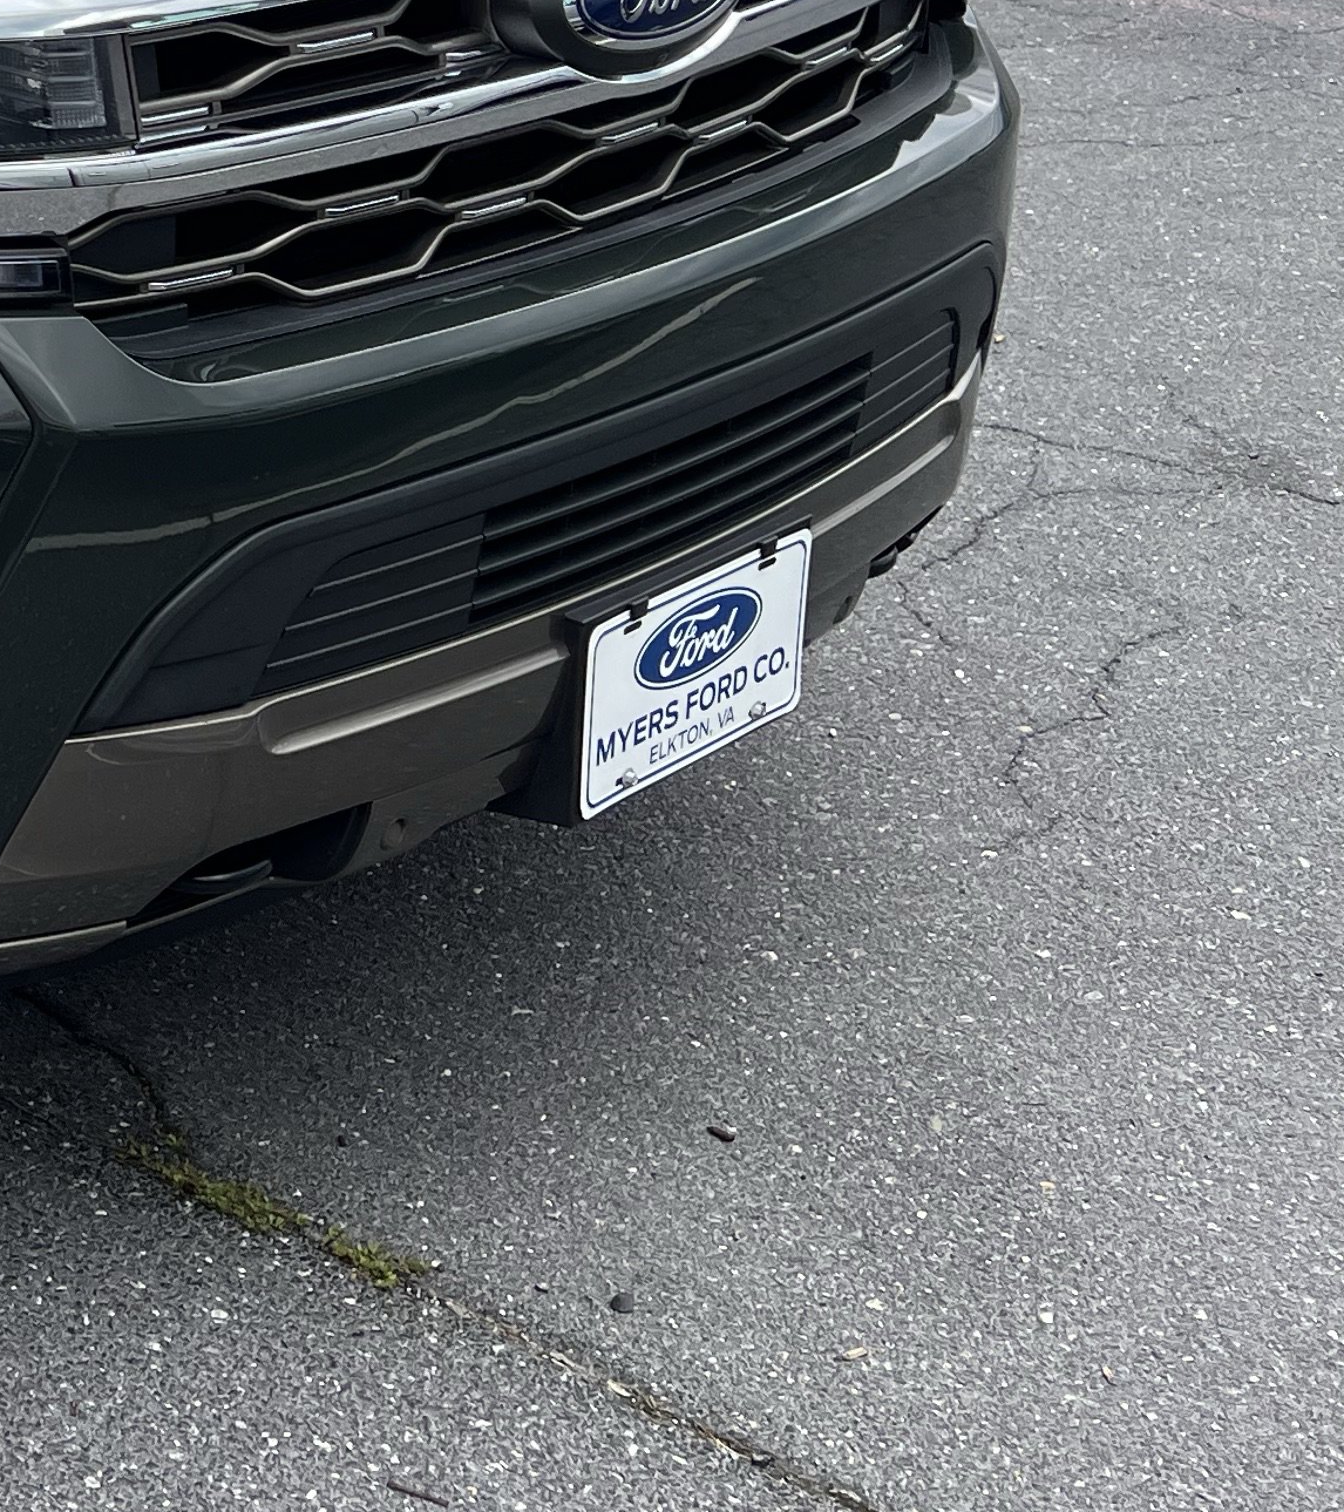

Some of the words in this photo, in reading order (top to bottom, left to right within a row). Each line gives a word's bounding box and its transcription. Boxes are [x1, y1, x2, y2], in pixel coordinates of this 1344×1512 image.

[659, 603, 739, 678] Ford
[596, 699, 679, 766] MYERS
[685, 666, 747, 720] FORD
[754, 646, 790, 683] CO.
[649, 721, 714, 765] ELKTON,
[719, 706, 735, 728] VA
